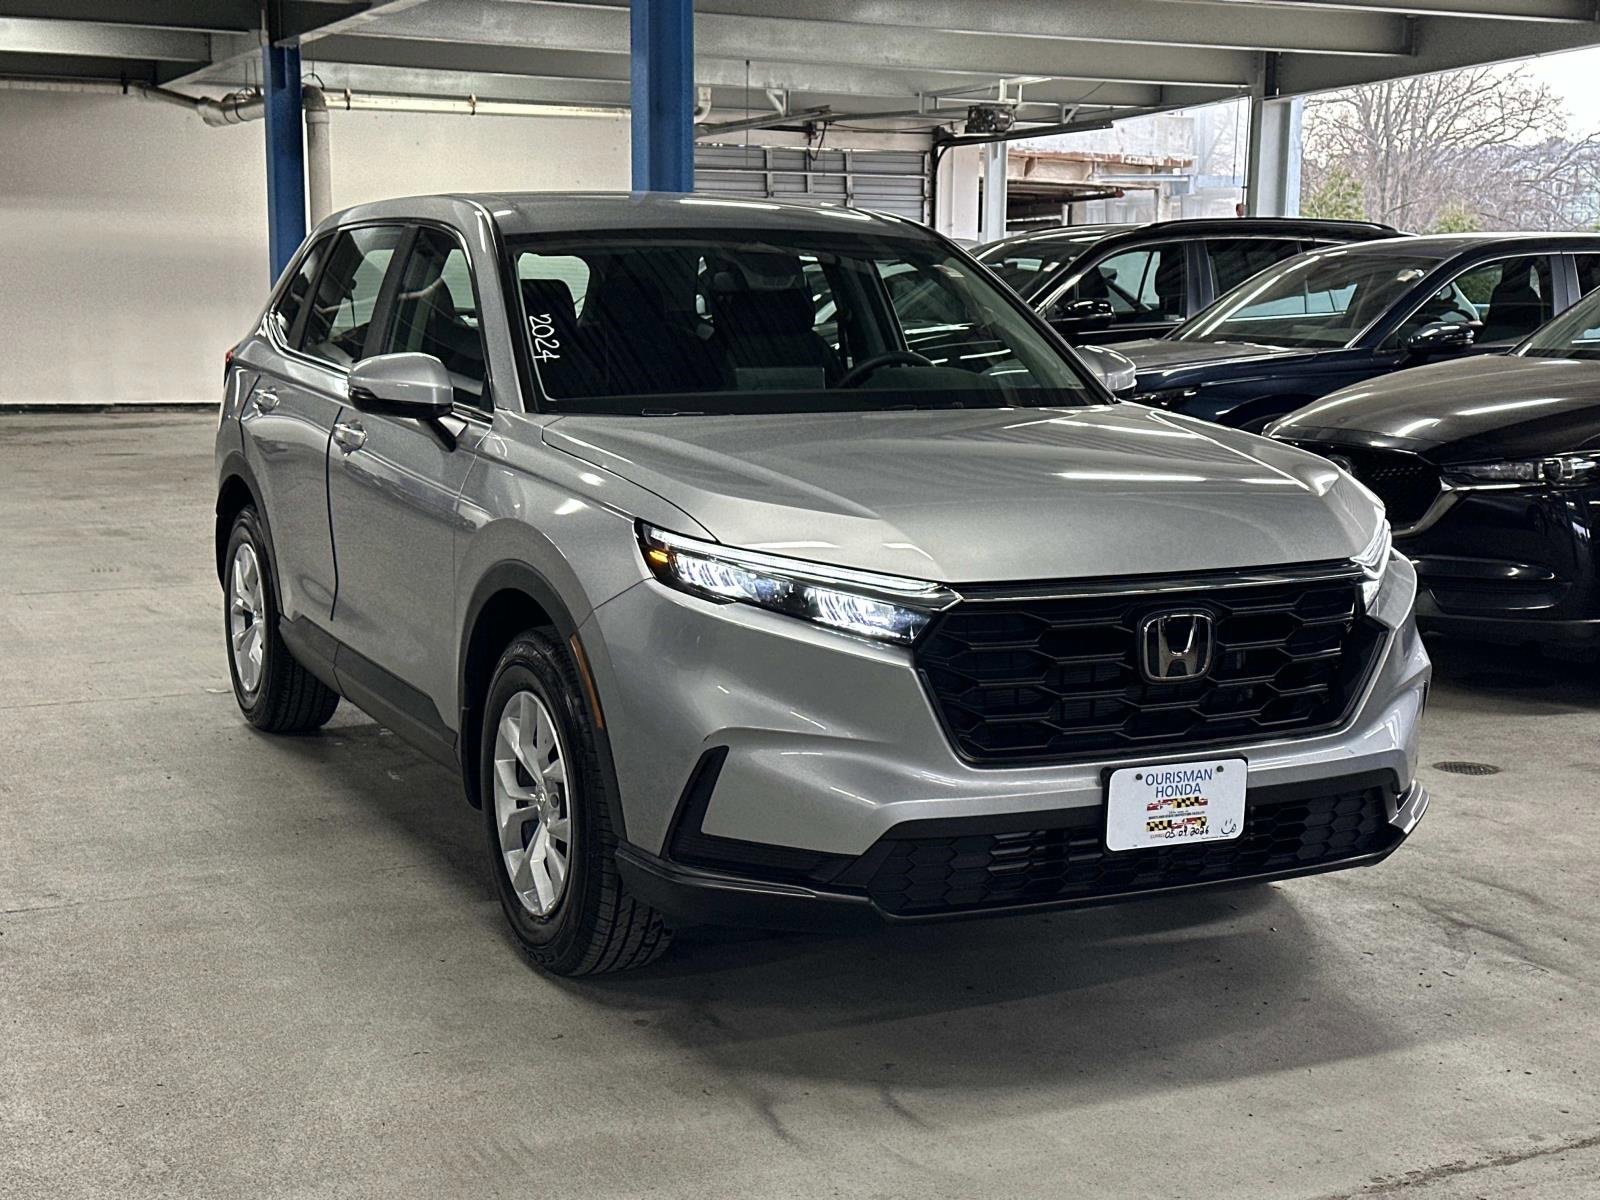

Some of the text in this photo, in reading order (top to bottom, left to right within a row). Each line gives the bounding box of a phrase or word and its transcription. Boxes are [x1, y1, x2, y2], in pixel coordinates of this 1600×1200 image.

[529, 313, 560, 363] 2024
[1145, 768, 1213, 786] OURISMAN
[1155, 783, 1202, 798] HONDA
